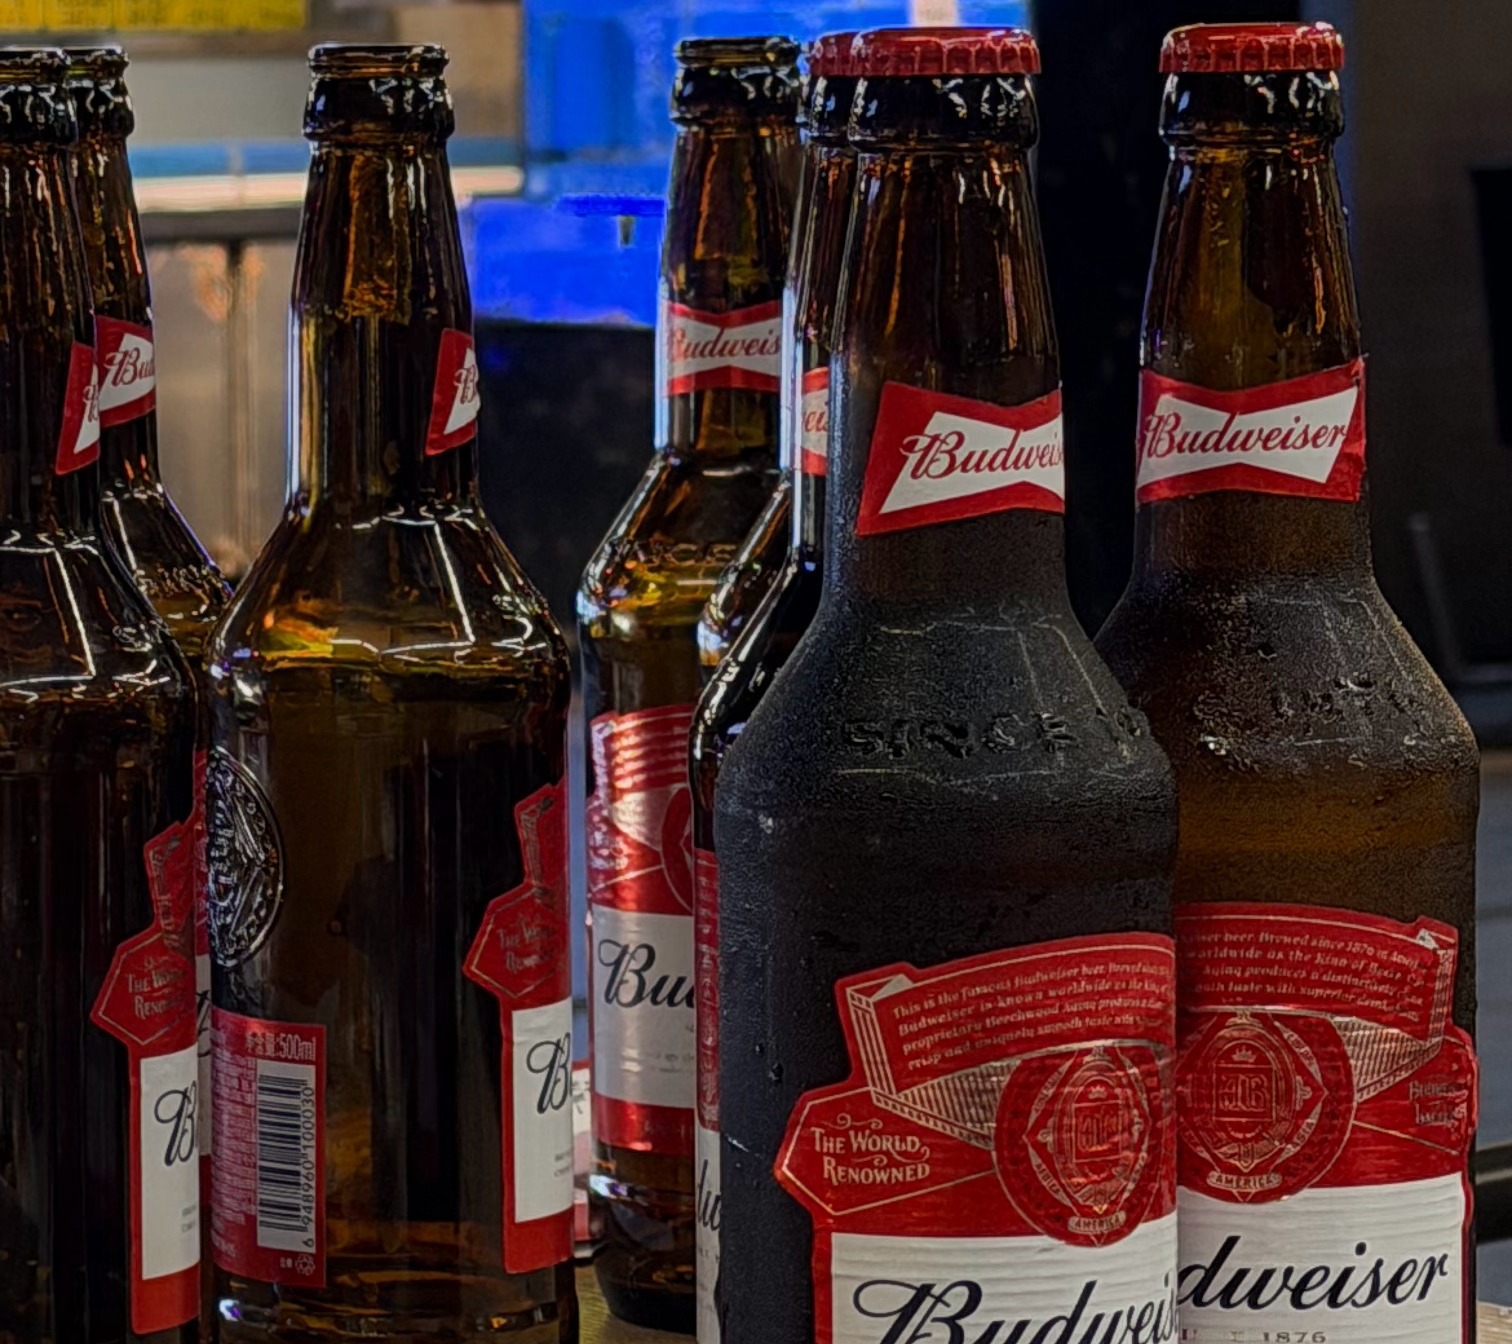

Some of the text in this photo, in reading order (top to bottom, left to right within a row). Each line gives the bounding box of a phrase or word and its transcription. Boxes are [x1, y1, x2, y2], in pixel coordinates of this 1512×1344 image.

[1144, 412, 1347, 458] Budweiser
[598, 938, 696, 1009] Bu
[1177, 1236, 1449, 1312] dweiser
[1262, 1331, 1327, 1344] 1876
